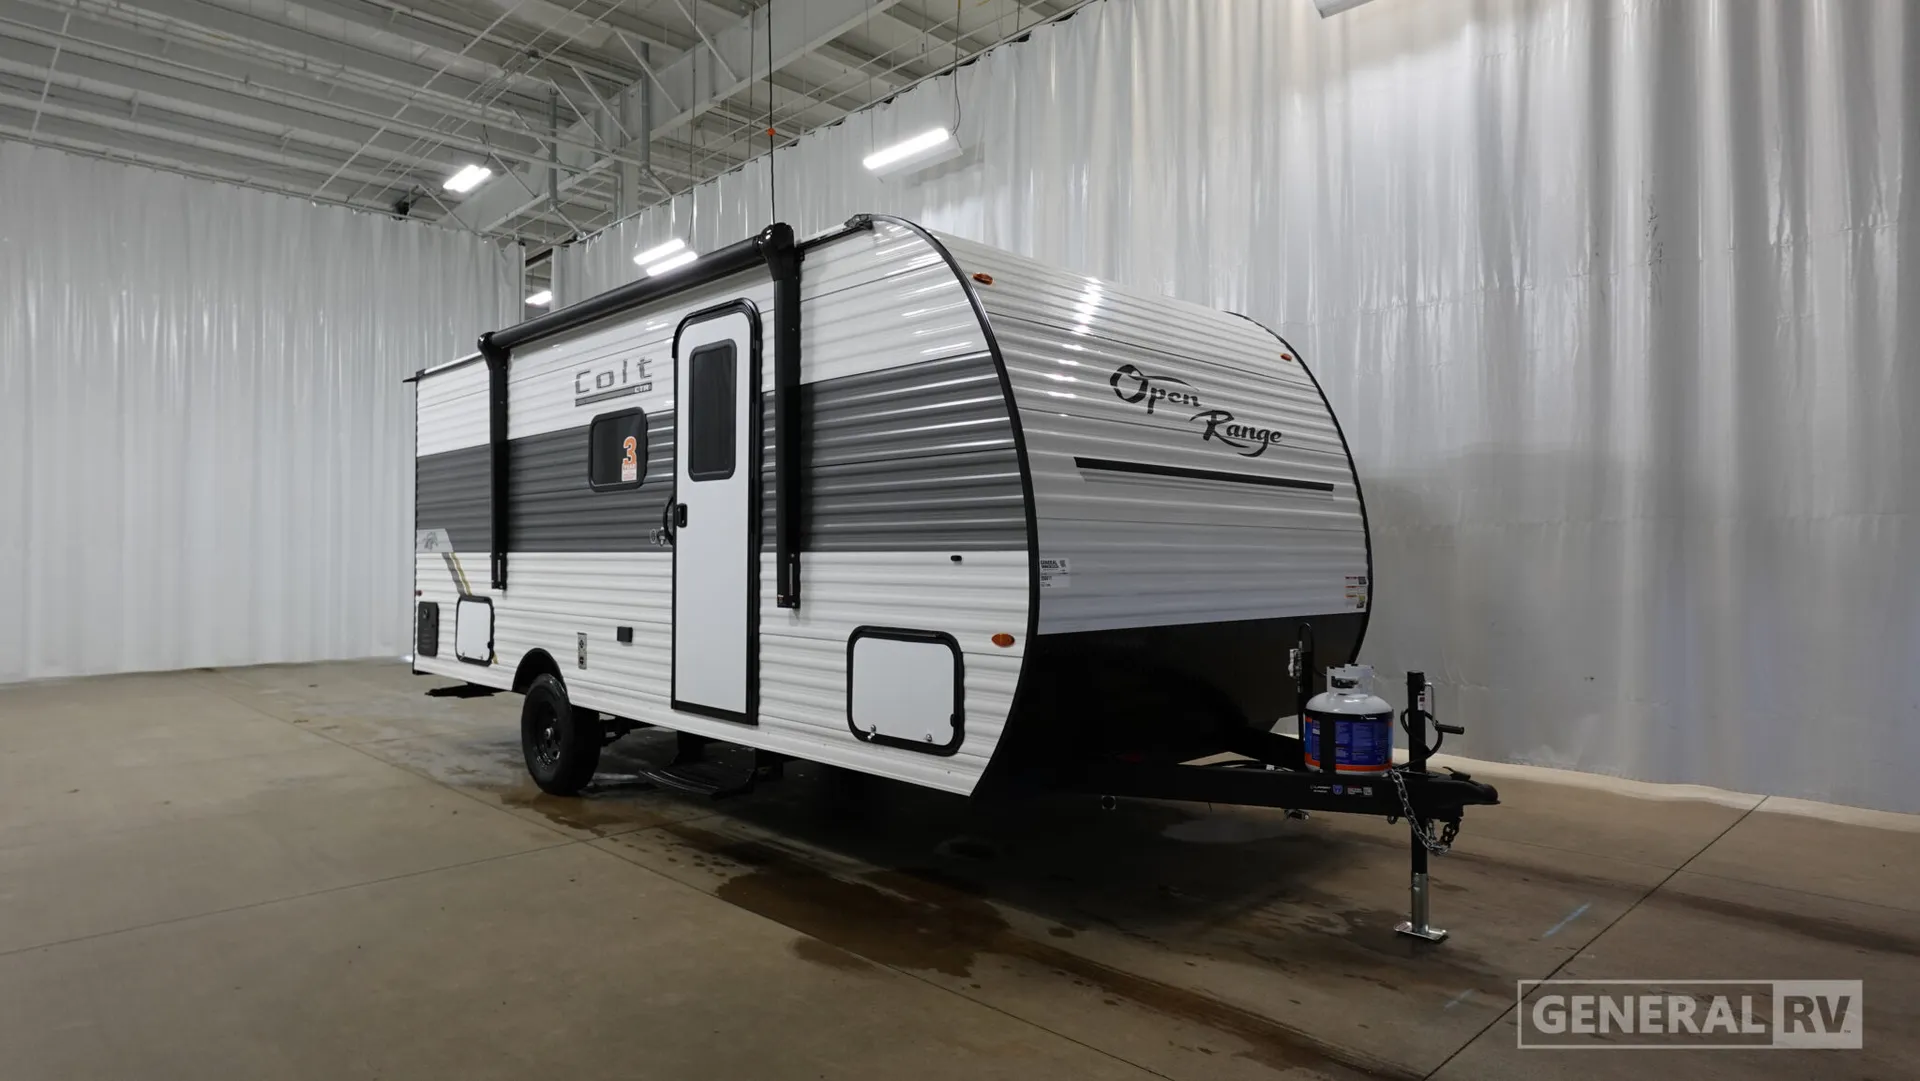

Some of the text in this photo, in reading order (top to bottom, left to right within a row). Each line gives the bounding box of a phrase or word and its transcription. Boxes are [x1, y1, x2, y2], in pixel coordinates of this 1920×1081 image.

[575, 357, 652, 394] Colt
[634, 384, 649, 393] CTR
[1110, 364, 1200, 414] Open
[623, 436, 637, 465] 3
[1189, 409, 1282, 457] Range
